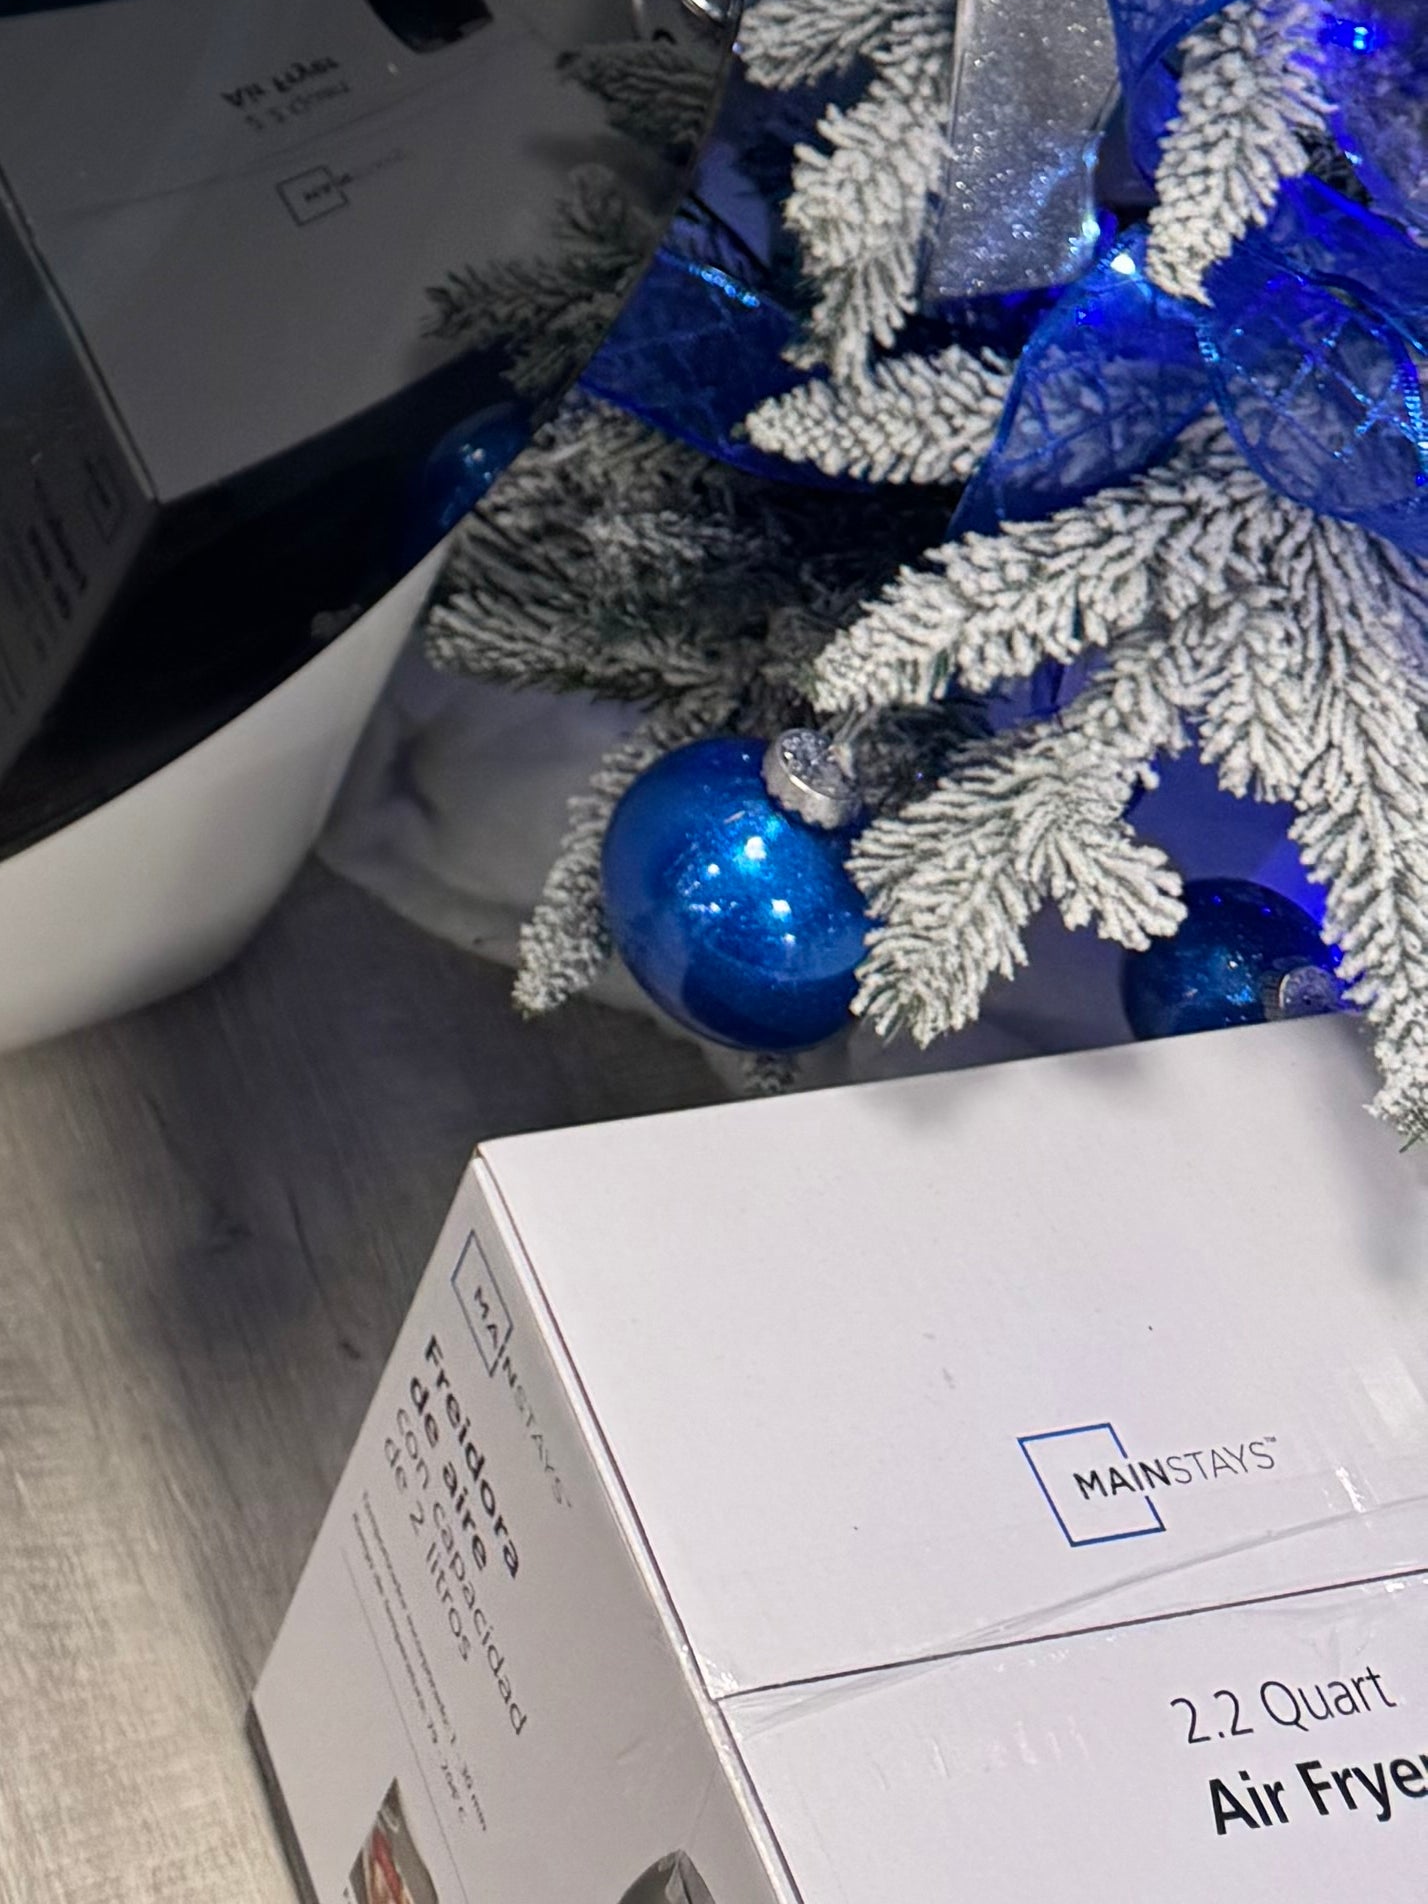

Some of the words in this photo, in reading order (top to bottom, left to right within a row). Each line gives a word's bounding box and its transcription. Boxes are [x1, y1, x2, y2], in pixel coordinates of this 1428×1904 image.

[383, 1436, 408, 1495] de
[409, 1500, 425, 1538] 2
[425, 1541, 472, 1663] litros
[409, 1375, 440, 1449] de
[442, 1459, 487, 1572] aire
[424, 1333, 521, 1580] Freidora
[395, 1407, 430, 1491] con
[432, 1501, 528, 1737] capacidad
[1169, 1689, 1255, 1745] 2.2
[1259, 1665, 1398, 1733] Quart
[1207, 1770, 1290, 1837] Air
